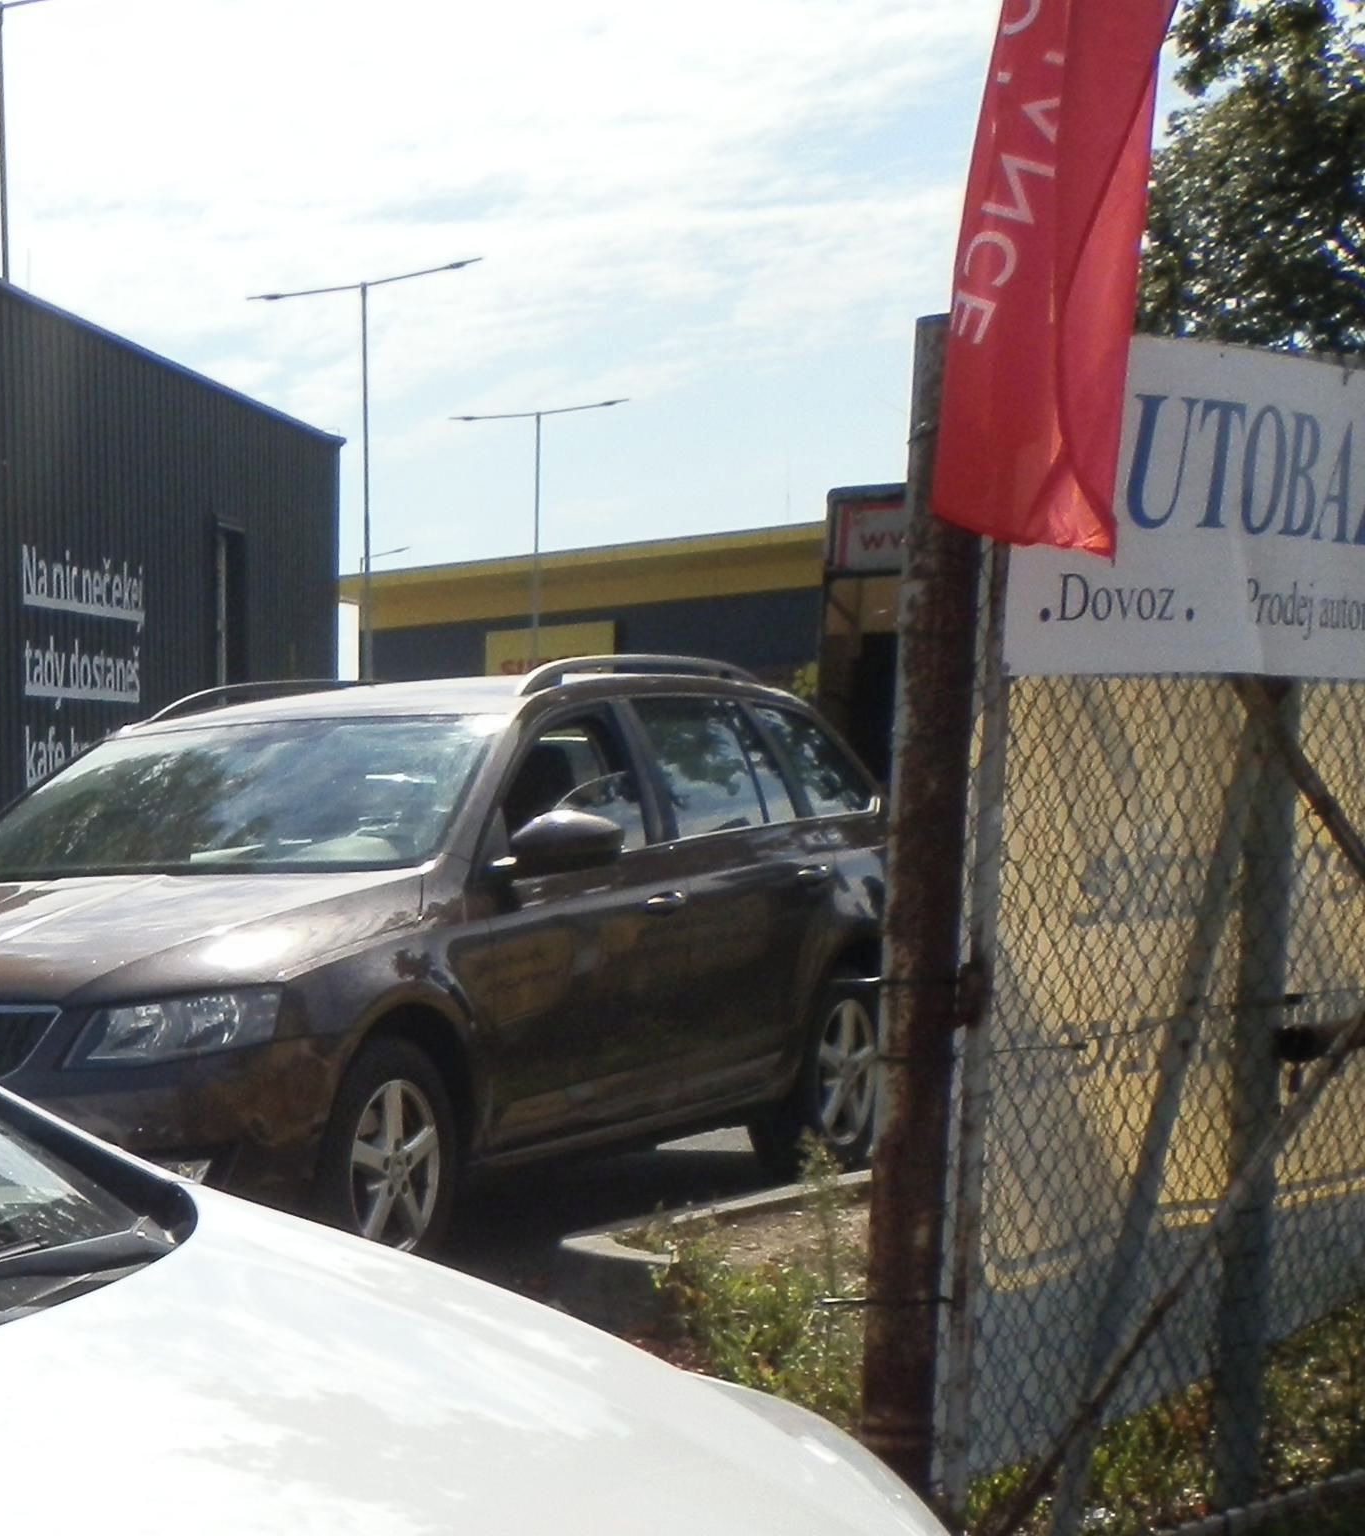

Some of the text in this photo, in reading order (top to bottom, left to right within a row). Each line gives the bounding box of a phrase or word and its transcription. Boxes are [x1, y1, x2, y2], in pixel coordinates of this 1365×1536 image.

[1126, 393, 1365, 546] UTOBA
[22, 543, 48, 604] Na
[52, 549, 78, 608] nic
[1057, 573, 1176, 622] Dovoz
[1318, 594, 1365, 631] auto
[25, 635, 66, 710] tady
[70, 639, 141, 703] dostaneš
[25, 725, 66, 787] kafe
